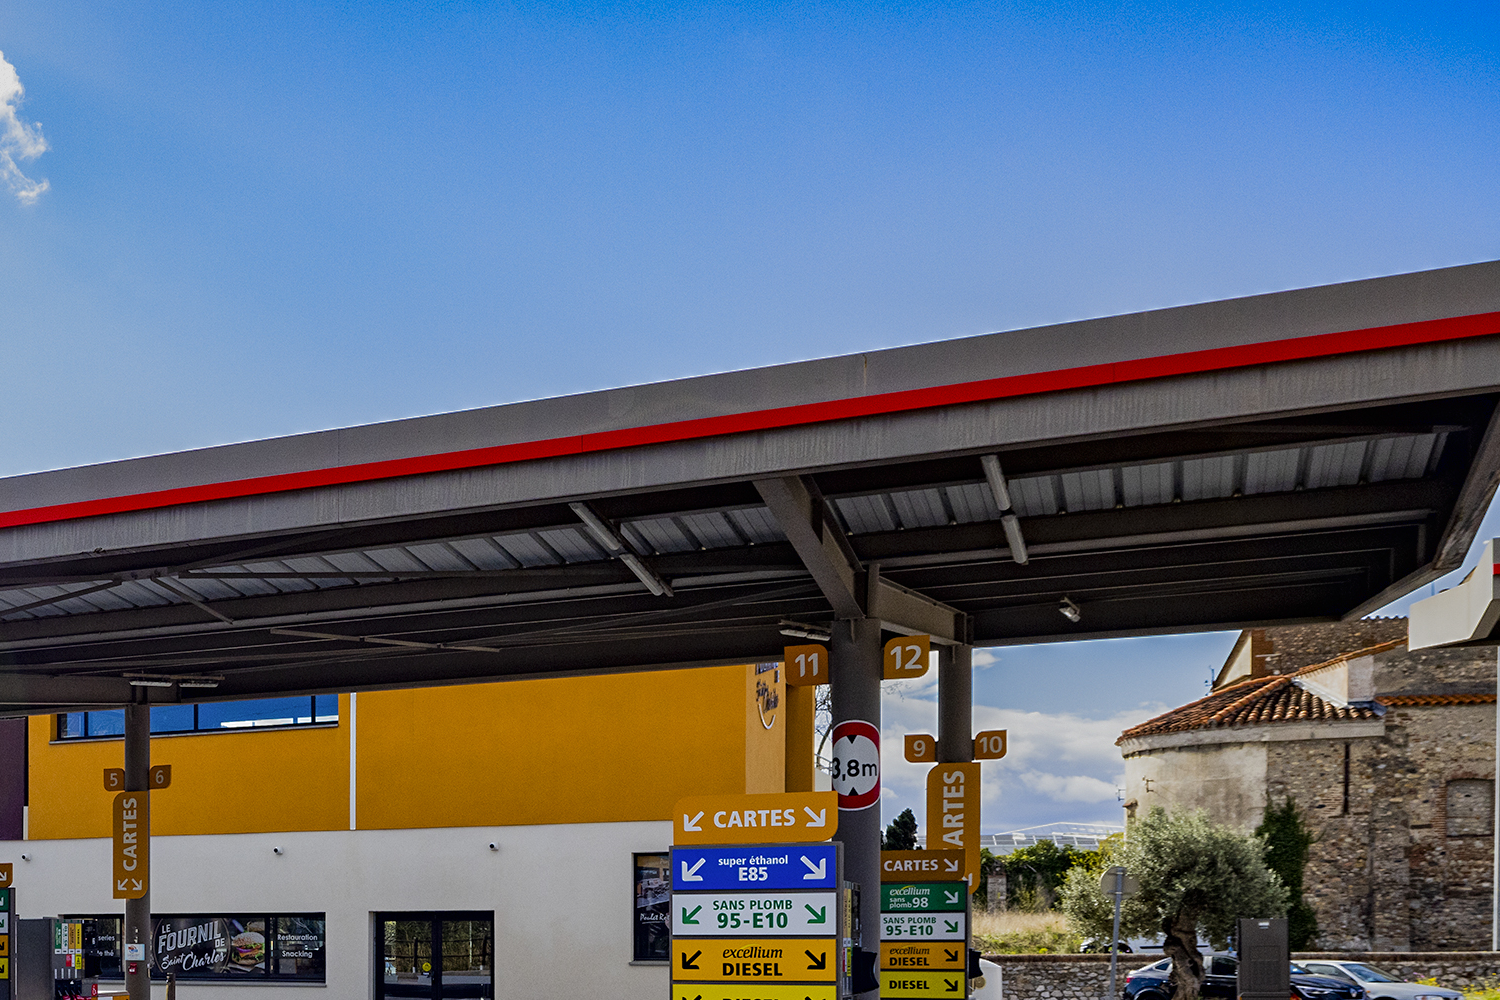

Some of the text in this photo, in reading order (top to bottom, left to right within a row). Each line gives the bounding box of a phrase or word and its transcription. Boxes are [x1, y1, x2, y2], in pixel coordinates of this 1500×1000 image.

[890, 645, 923, 670] 12
[794, 653, 818, 678] 11
[913, 740, 926, 757] 9
[979, 736, 1002, 753] 10
[832, 757, 877, 781] 3,8m
[110, 773, 118, 787] 5
[155, 770, 164, 784] 6
[943, 770, 964, 850] ARTES
[713, 809, 796, 828] CARTES
[123, 797, 137, 871] CARTES
[718, 855, 789, 868] super éthanol
[884, 859, 939, 872] CARTES
[738, 867, 768, 882] E85
[889, 887, 930, 896] excellium
[713, 900, 793, 910] SANS PLOMB
[889, 897, 929, 910] plomb 98
[717, 912, 789, 929] 95-E10
[162, 923, 171, 934] LE
[886, 925, 934, 936] 95-E10
[157, 920, 222, 954] FOURNIL
[215, 938, 225, 948] DE
[282, 951, 313, 959] Snacking
[722, 946, 783, 959] excellium
[889, 946, 930, 955] excellium
[161, 949, 227, 971] Saint Charles
[889, 957, 930, 966] DIESEL
[722, 963, 783, 977] DIESEL
[889, 980, 930, 990] DIESEL
